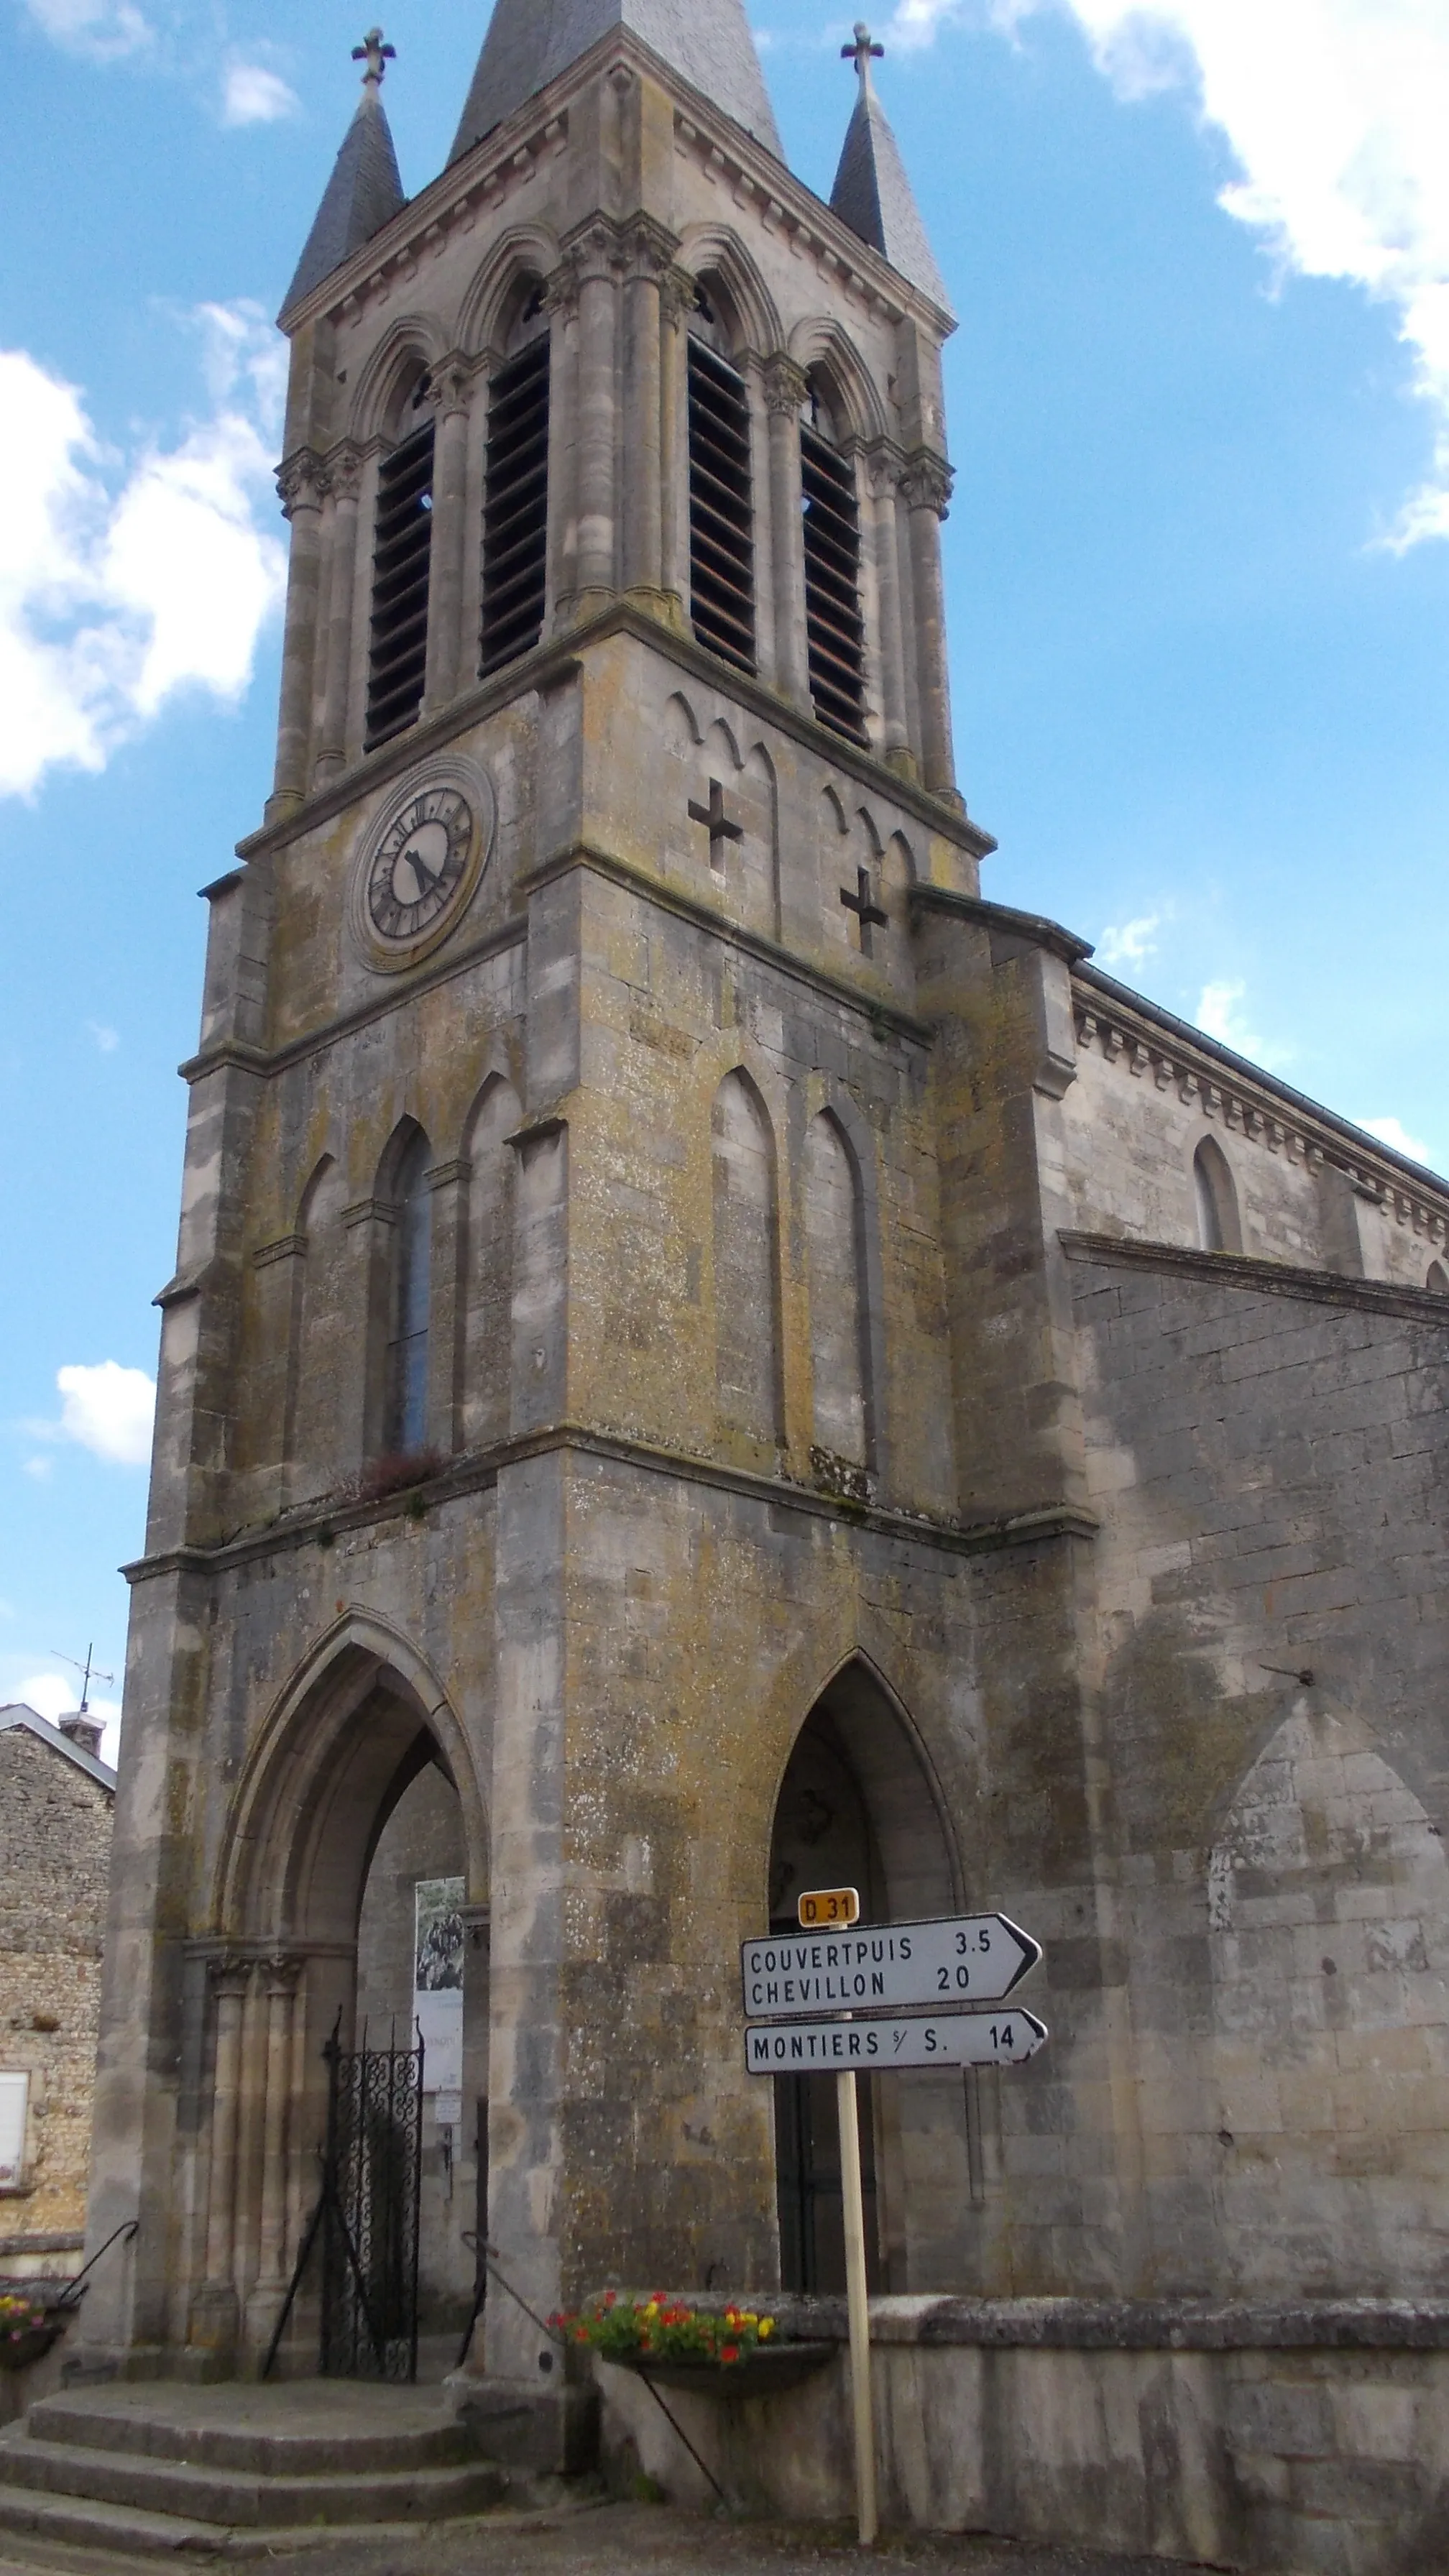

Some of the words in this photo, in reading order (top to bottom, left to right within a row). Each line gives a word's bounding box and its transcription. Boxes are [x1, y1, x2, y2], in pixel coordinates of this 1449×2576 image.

[805, 1899, 817, 1921] D
[827, 1895, 850, 1919] 31
[750, 1937, 912, 1974] COUVERTPUIS
[955, 1929, 991, 1955] 3.5
[752, 1971, 885, 2005] CHEVILLON
[937, 1964, 970, 1991] 20
[754, 2031, 879, 2059] MONTIERS
[924, 2028, 948, 2052] S.
[989, 2024, 1014, 2049] 14
